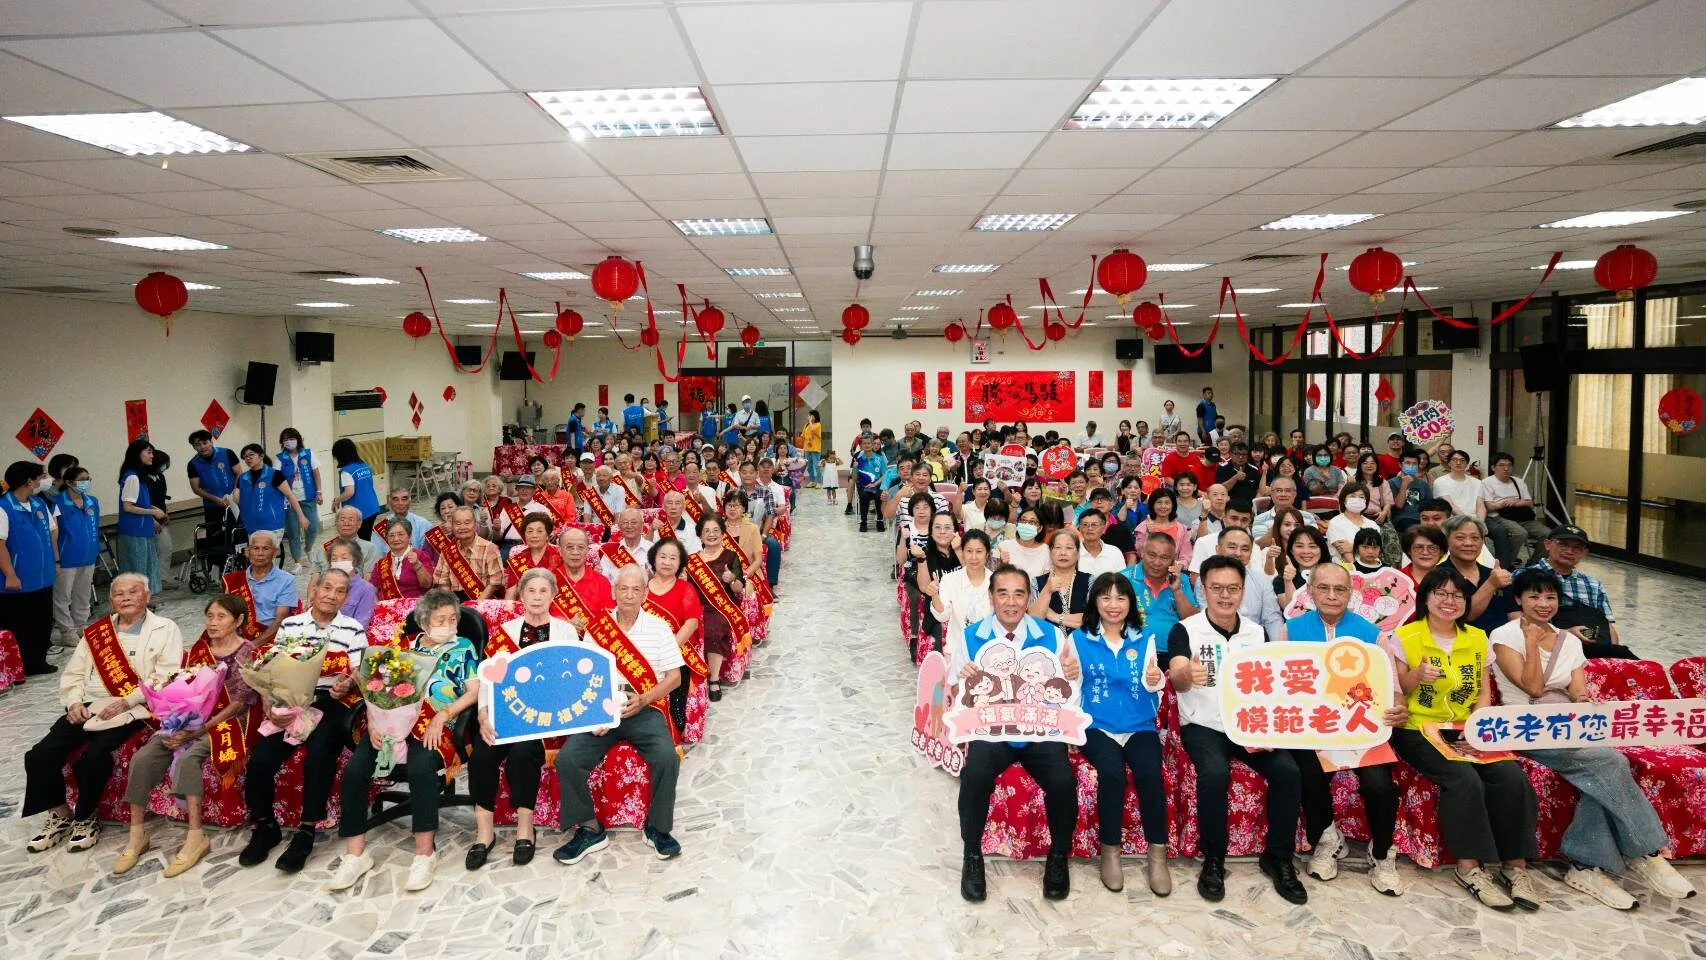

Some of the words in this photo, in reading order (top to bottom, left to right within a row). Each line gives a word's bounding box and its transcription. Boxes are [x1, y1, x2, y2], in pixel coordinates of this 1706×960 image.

[28, 417, 53, 439] 福
[1410, 407, 1440, 429] 放閃
[1417, 416, 1449, 439] 60年
[1234, 659, 1320, 695] 我愛
[501, 685, 553, 727] 笑口常開
[978, 705, 1060, 727] 福氣滿滿
[1236, 704, 1379, 735] 模範老人
[1477, 703, 1706, 742] 敬老有您最幸福
